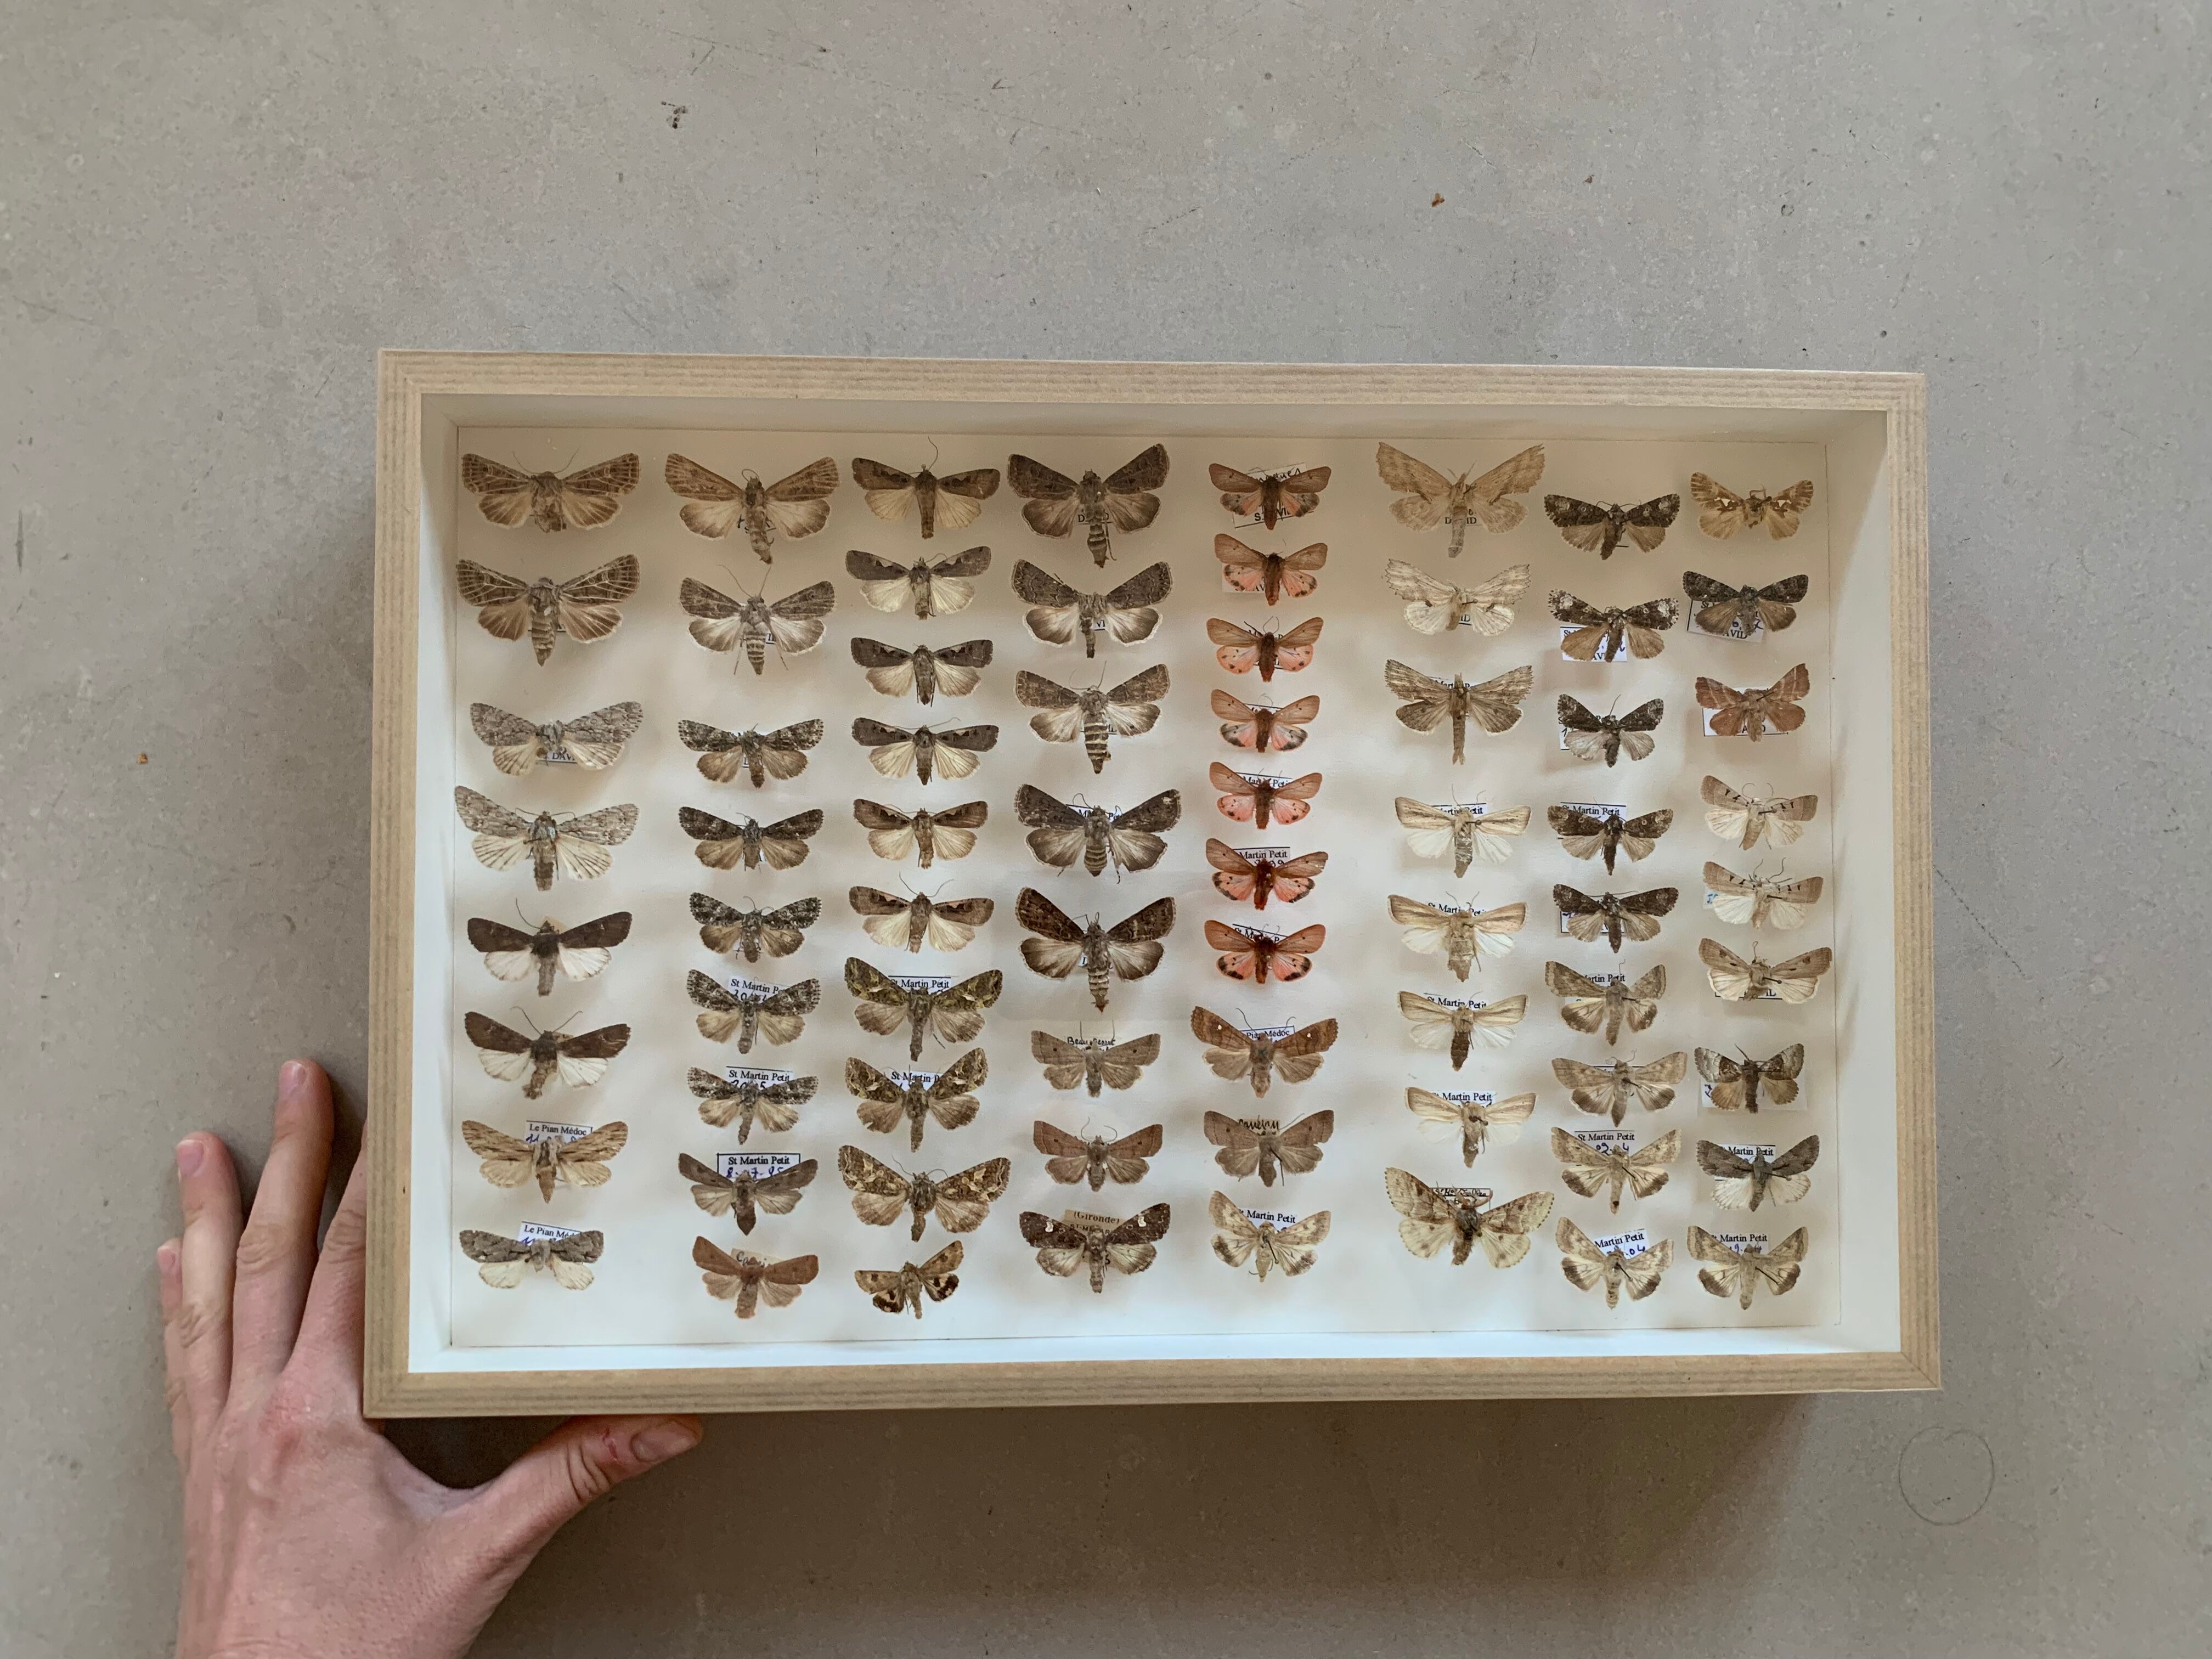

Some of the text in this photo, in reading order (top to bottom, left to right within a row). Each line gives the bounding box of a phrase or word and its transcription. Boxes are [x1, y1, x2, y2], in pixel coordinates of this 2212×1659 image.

[1573, 806, 1599, 815] Martin
[1239, 850, 1288, 859] Martin Petit
[730, 978, 740, 987] St
[742, 980, 770, 993] Martin
[901, 979, 929, 988] Martin
[931, 980, 950, 989] Petit
[1438, 997, 1465, 1007] Martin
[729, 1069, 790, 1081] St Martin Petit
[890, 1071, 900, 1080] St
[1442, 1093, 1470, 1101] Martin
[1473, 1092, 1492, 1101] Petit
[529, 1124, 587, 1136] Le Pian Médoc
[1588, 1132, 1614, 1141] Martin
[1728, 1146, 1753, 1155] Martin
[728, 1155, 790, 1165] St Martin Petit
[1246, 1210, 1296, 1223] Martin Petit
[524, 1224, 534, 1233] Le
[537, 1227, 554, 1236] Pian
[1594, 1232, 1645, 1248] Martin Petit
[1750, 1233, 1768, 1242] Petit
